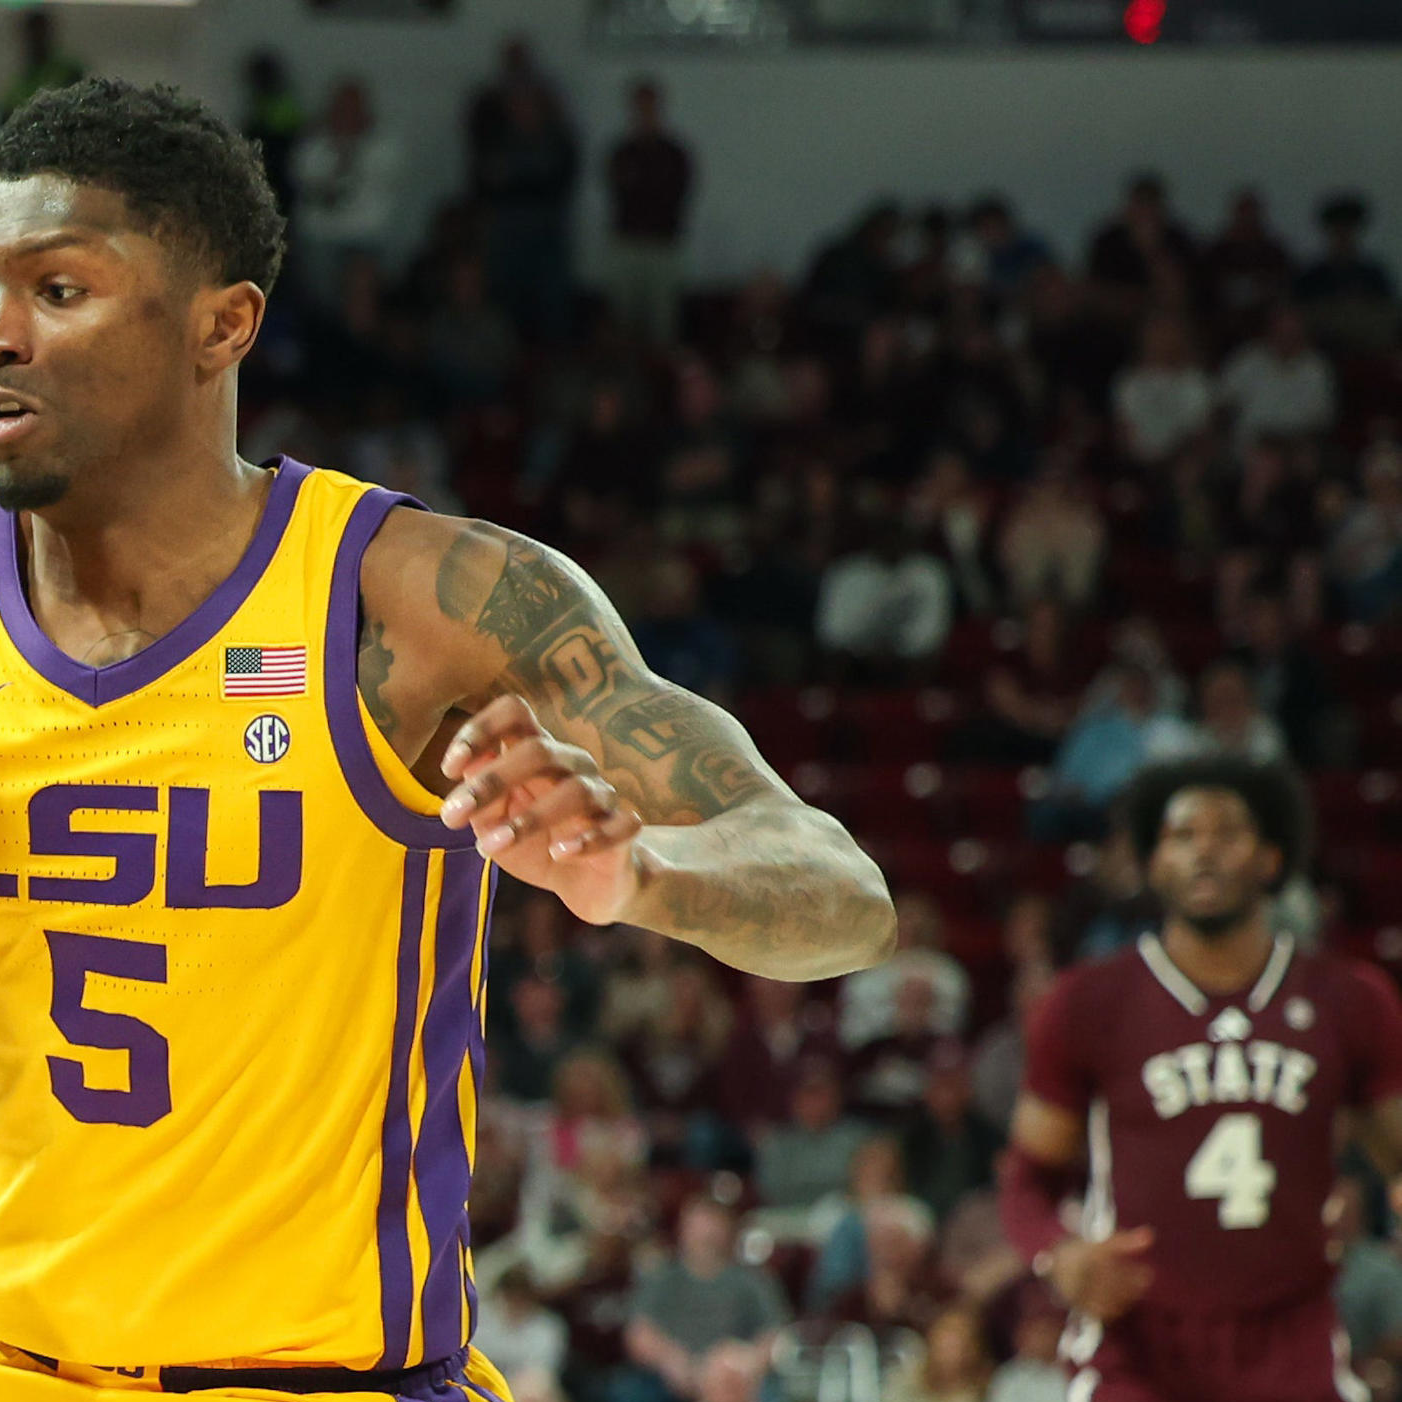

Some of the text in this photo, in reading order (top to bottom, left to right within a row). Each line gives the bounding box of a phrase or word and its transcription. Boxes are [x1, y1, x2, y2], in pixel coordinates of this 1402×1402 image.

[246, 717, 289, 761] SEC
[43, 929, 173, 1128] 5
[1142, 1040, 1317, 1120] STATE
[1184, 1112, 1277, 1230] 4
